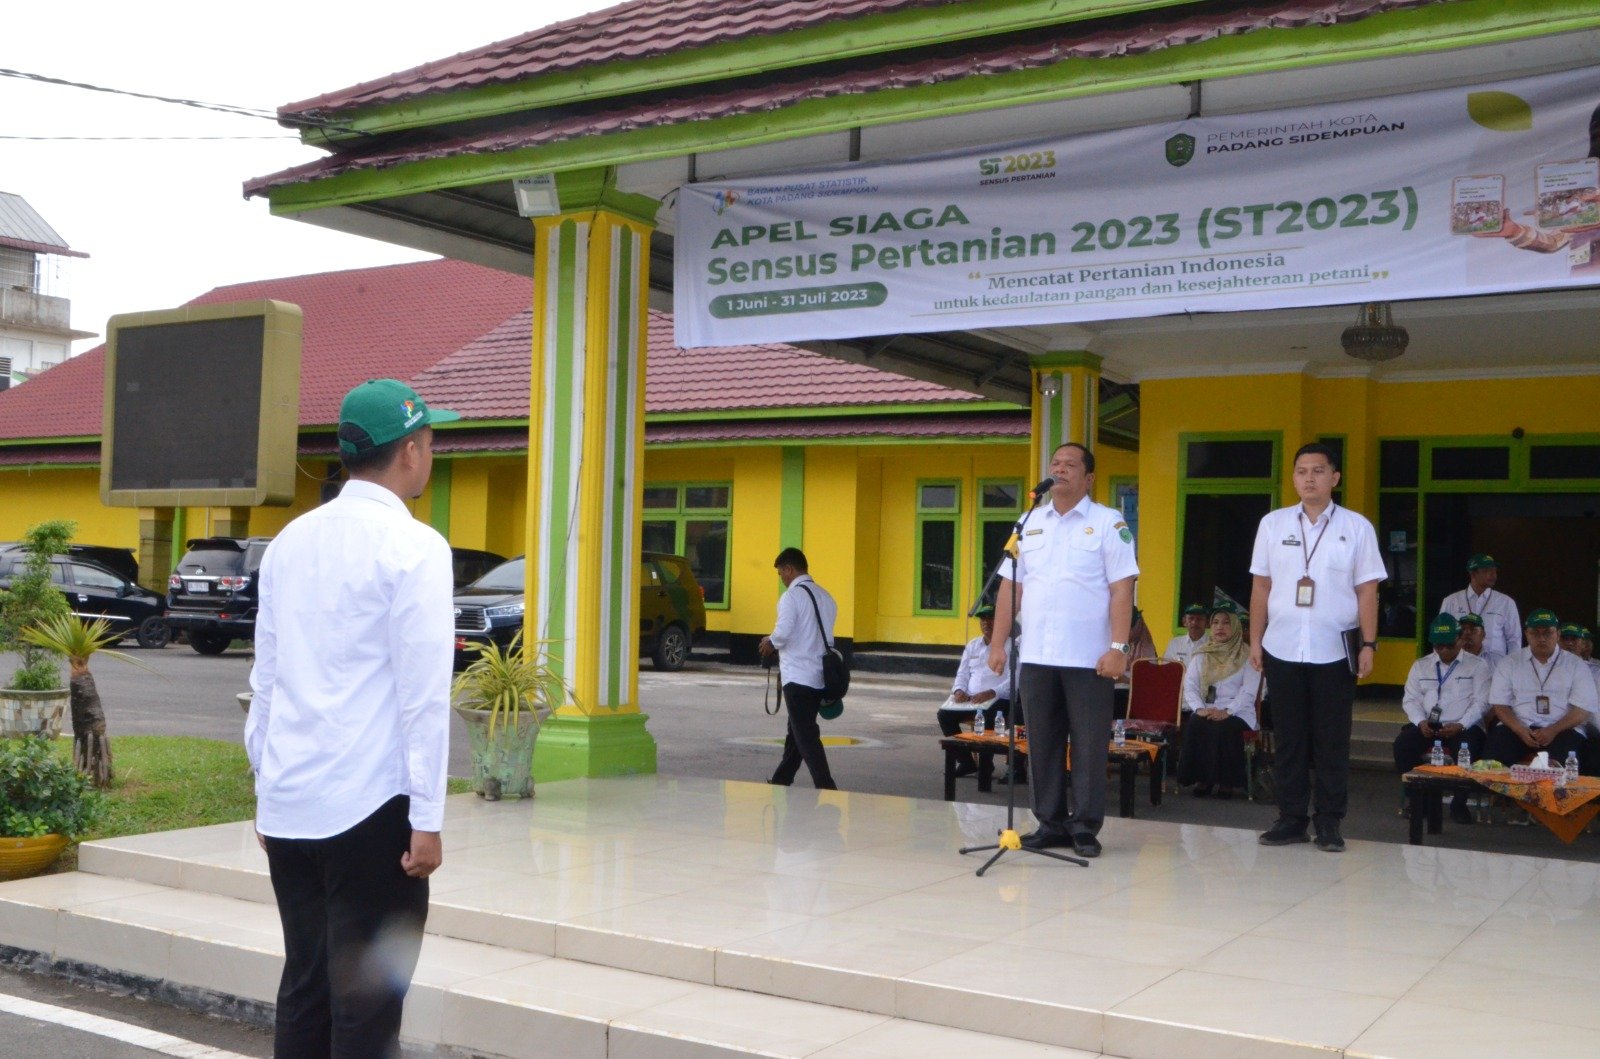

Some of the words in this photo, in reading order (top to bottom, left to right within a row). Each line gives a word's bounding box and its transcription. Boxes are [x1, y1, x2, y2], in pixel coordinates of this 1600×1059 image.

[1207, 120, 1323, 143] PEMERINTAH
[1330, 113, 1378, 127] KOTA
[1207, 137, 1283, 154] PADANG
[1289, 122, 1405, 144] SIDEMPUAN
[747, 185, 782, 196] BADAN
[783, 182, 815, 192] PUSAT
[819, 176, 868, 189] STATISTIK
[980, 177, 1009, 186] SENSUS
[1011, 172, 1056, 183] PERTANIAN
[747, 197, 773, 206] KOTA
[775, 193, 815, 202] PADANG
[817, 186, 879, 199] SIDEMPUAN
[707, 252, 838, 286] Sensus
[851, 228, 1057, 272] Pertanian
[1071, 213, 1180, 253] 2023
[1198, 186, 1419, 249] (ST2023)
[710, 221, 818, 249] APEL
[829, 204, 970, 237] SIAGA
[1079, 263, 1175, 283] Pertanian
[1181, 252, 1286, 274] Indonesia
[727, 301, 733, 311] 1
[736, 298, 768, 311] Juni
[781, 295, 797, 308] 31
[800, 291, 827, 305] Juli
[831, 289, 868, 303] 2023
[934, 295, 979, 310] untuk
[982, 291, 1071, 307] kedaulatan
[1074, 286, 1137, 303] pangan
[1141, 282, 1172, 295] dan
[1177, 272, 1304, 294] kesejahteraan
